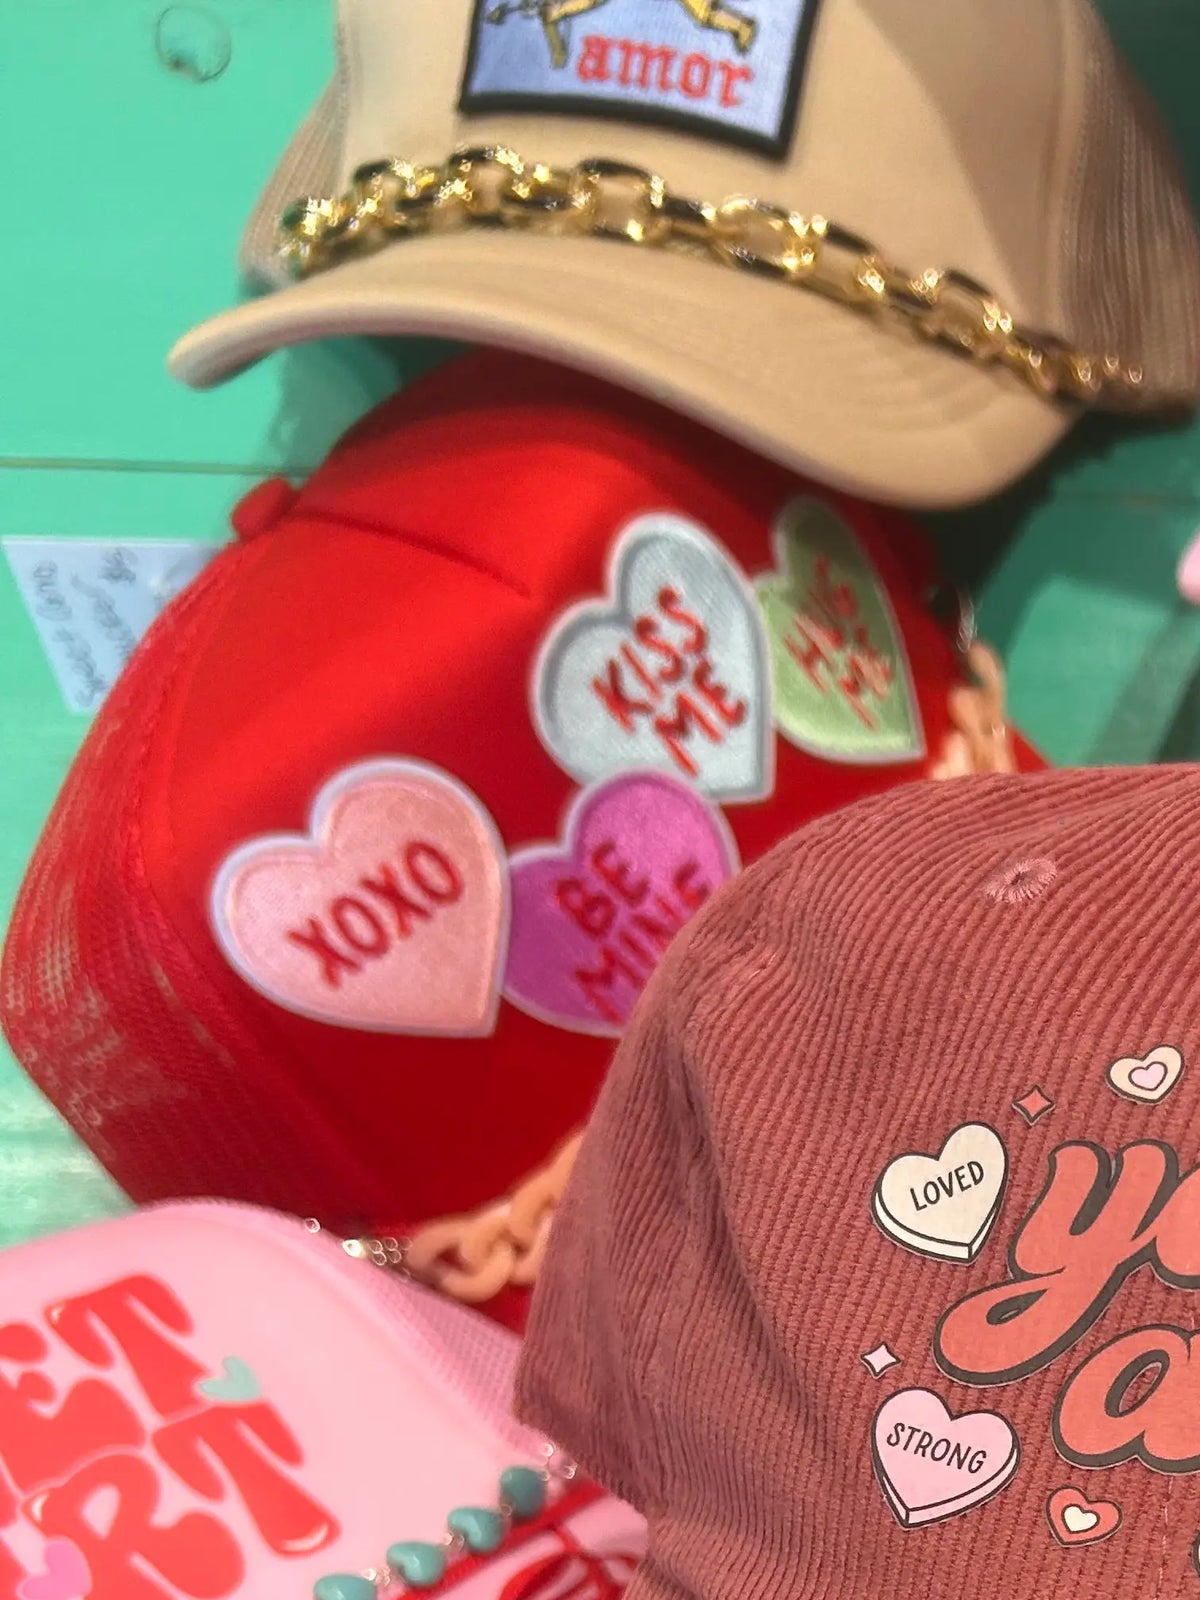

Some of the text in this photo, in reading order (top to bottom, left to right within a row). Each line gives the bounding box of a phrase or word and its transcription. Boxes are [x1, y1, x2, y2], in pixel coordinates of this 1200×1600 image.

[577, 35, 754, 108] amor
[592, 585, 709, 735] KISS
[654, 658, 746, 777] ME
[286, 839, 466, 989] XOXO
[555, 840, 649, 939] BE
[909, 1160, 985, 1211] LOVED
[886, 1422, 987, 1474] STRONG
